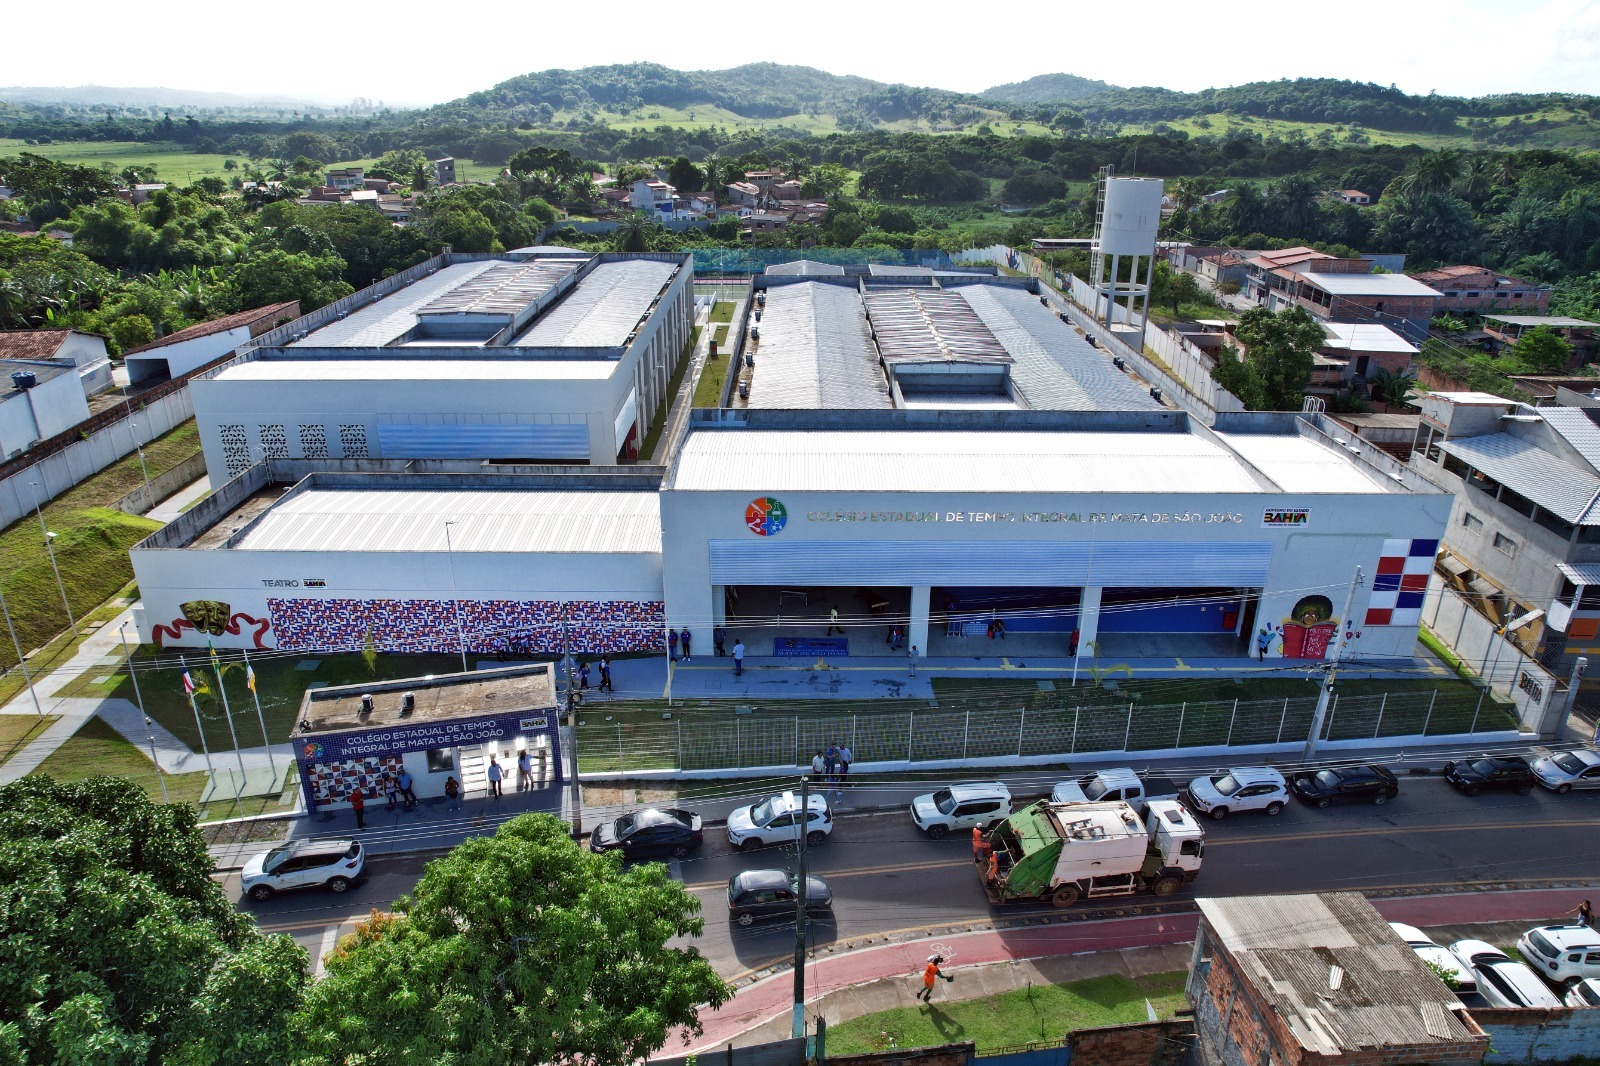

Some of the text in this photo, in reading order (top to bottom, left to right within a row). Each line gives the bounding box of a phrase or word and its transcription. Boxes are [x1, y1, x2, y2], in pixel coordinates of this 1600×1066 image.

[806, 509, 1243, 524] COLÉGIO ESTADUAL DE TEMPO INTEGRAL DE MATA DE SÃO JOÃO
[1263, 512, 1308, 523] BAHIA
[261, 579, 299, 588] TEATRO
[347, 720, 496, 745] COLÉGIO ESTADUAL DE TEMPO
[341, 728, 504, 756] INTEGRAL DE MATA DE SÃO JOÃO
